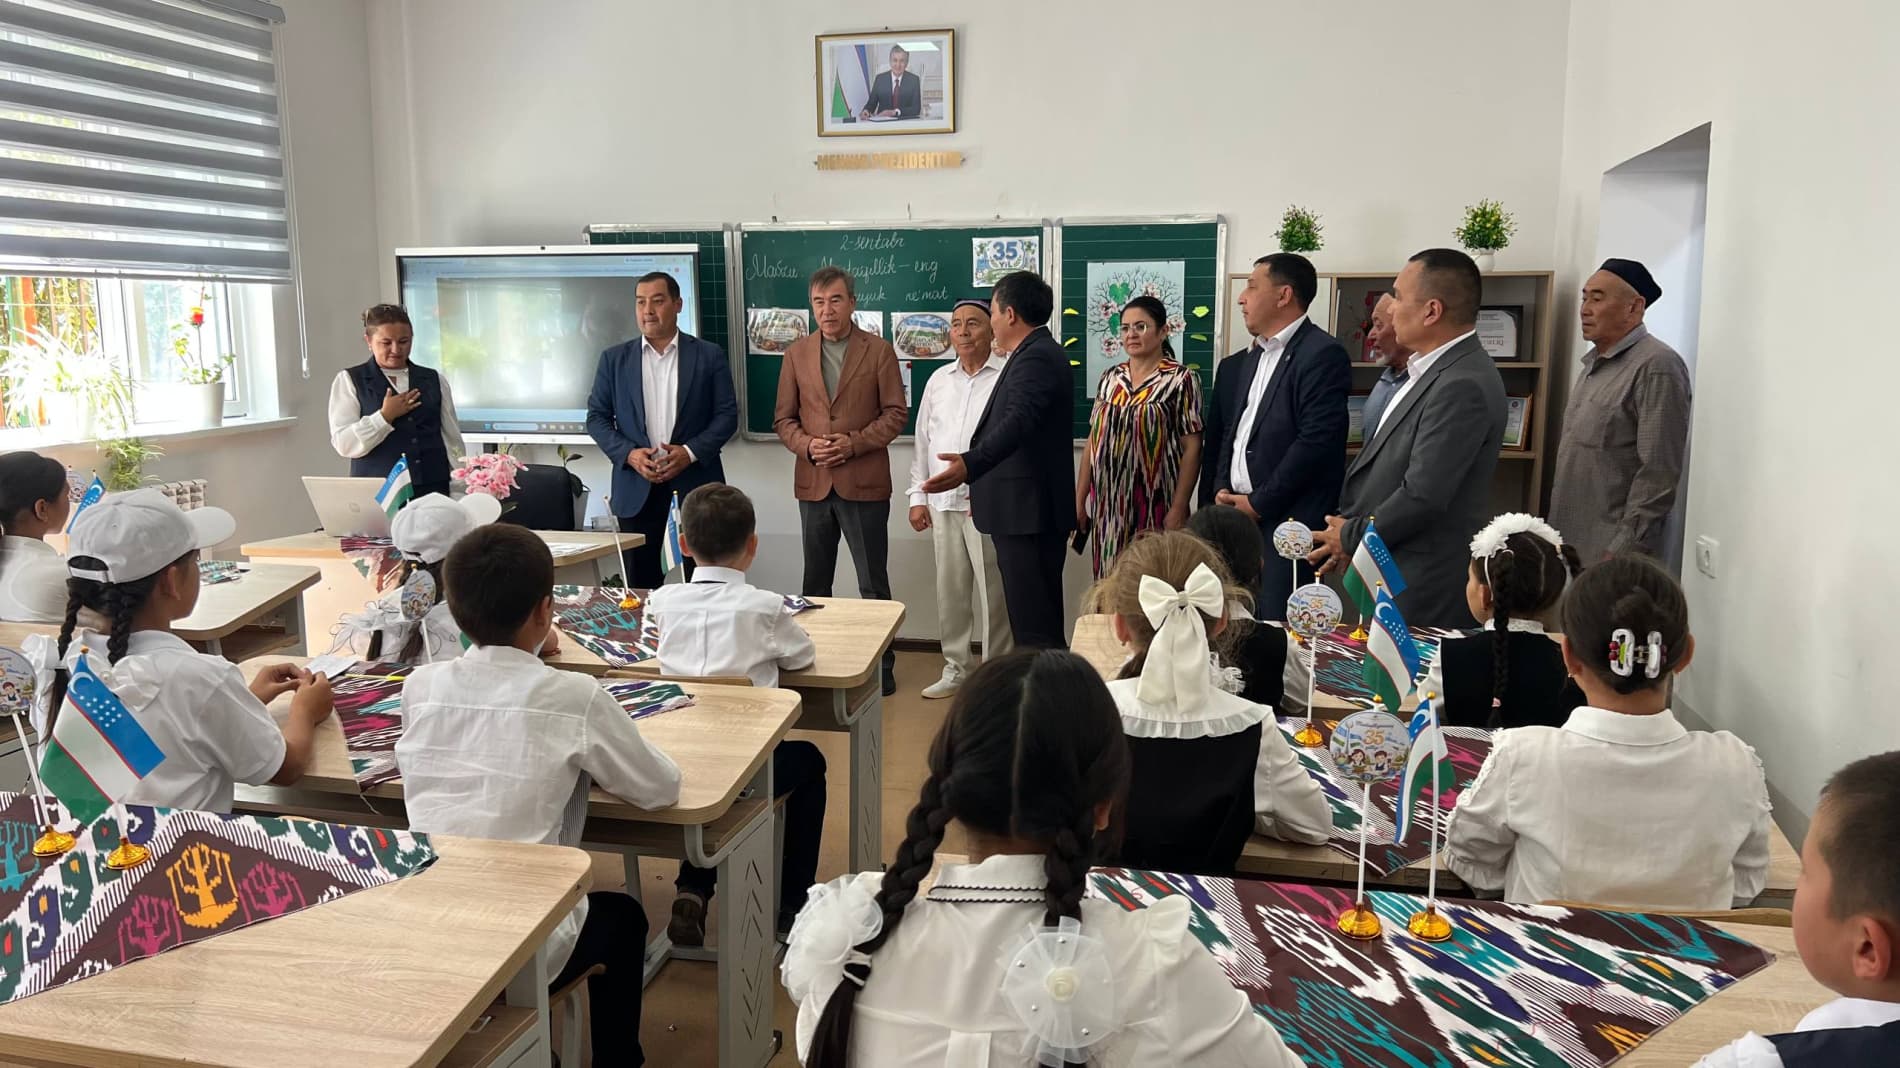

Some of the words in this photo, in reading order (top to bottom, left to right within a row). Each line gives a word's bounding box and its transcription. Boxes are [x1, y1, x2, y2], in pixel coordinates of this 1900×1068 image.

[993, 241, 1018, 260] 35
[914, 260, 938, 284] eng
[1363, 728, 1385, 746] 35
